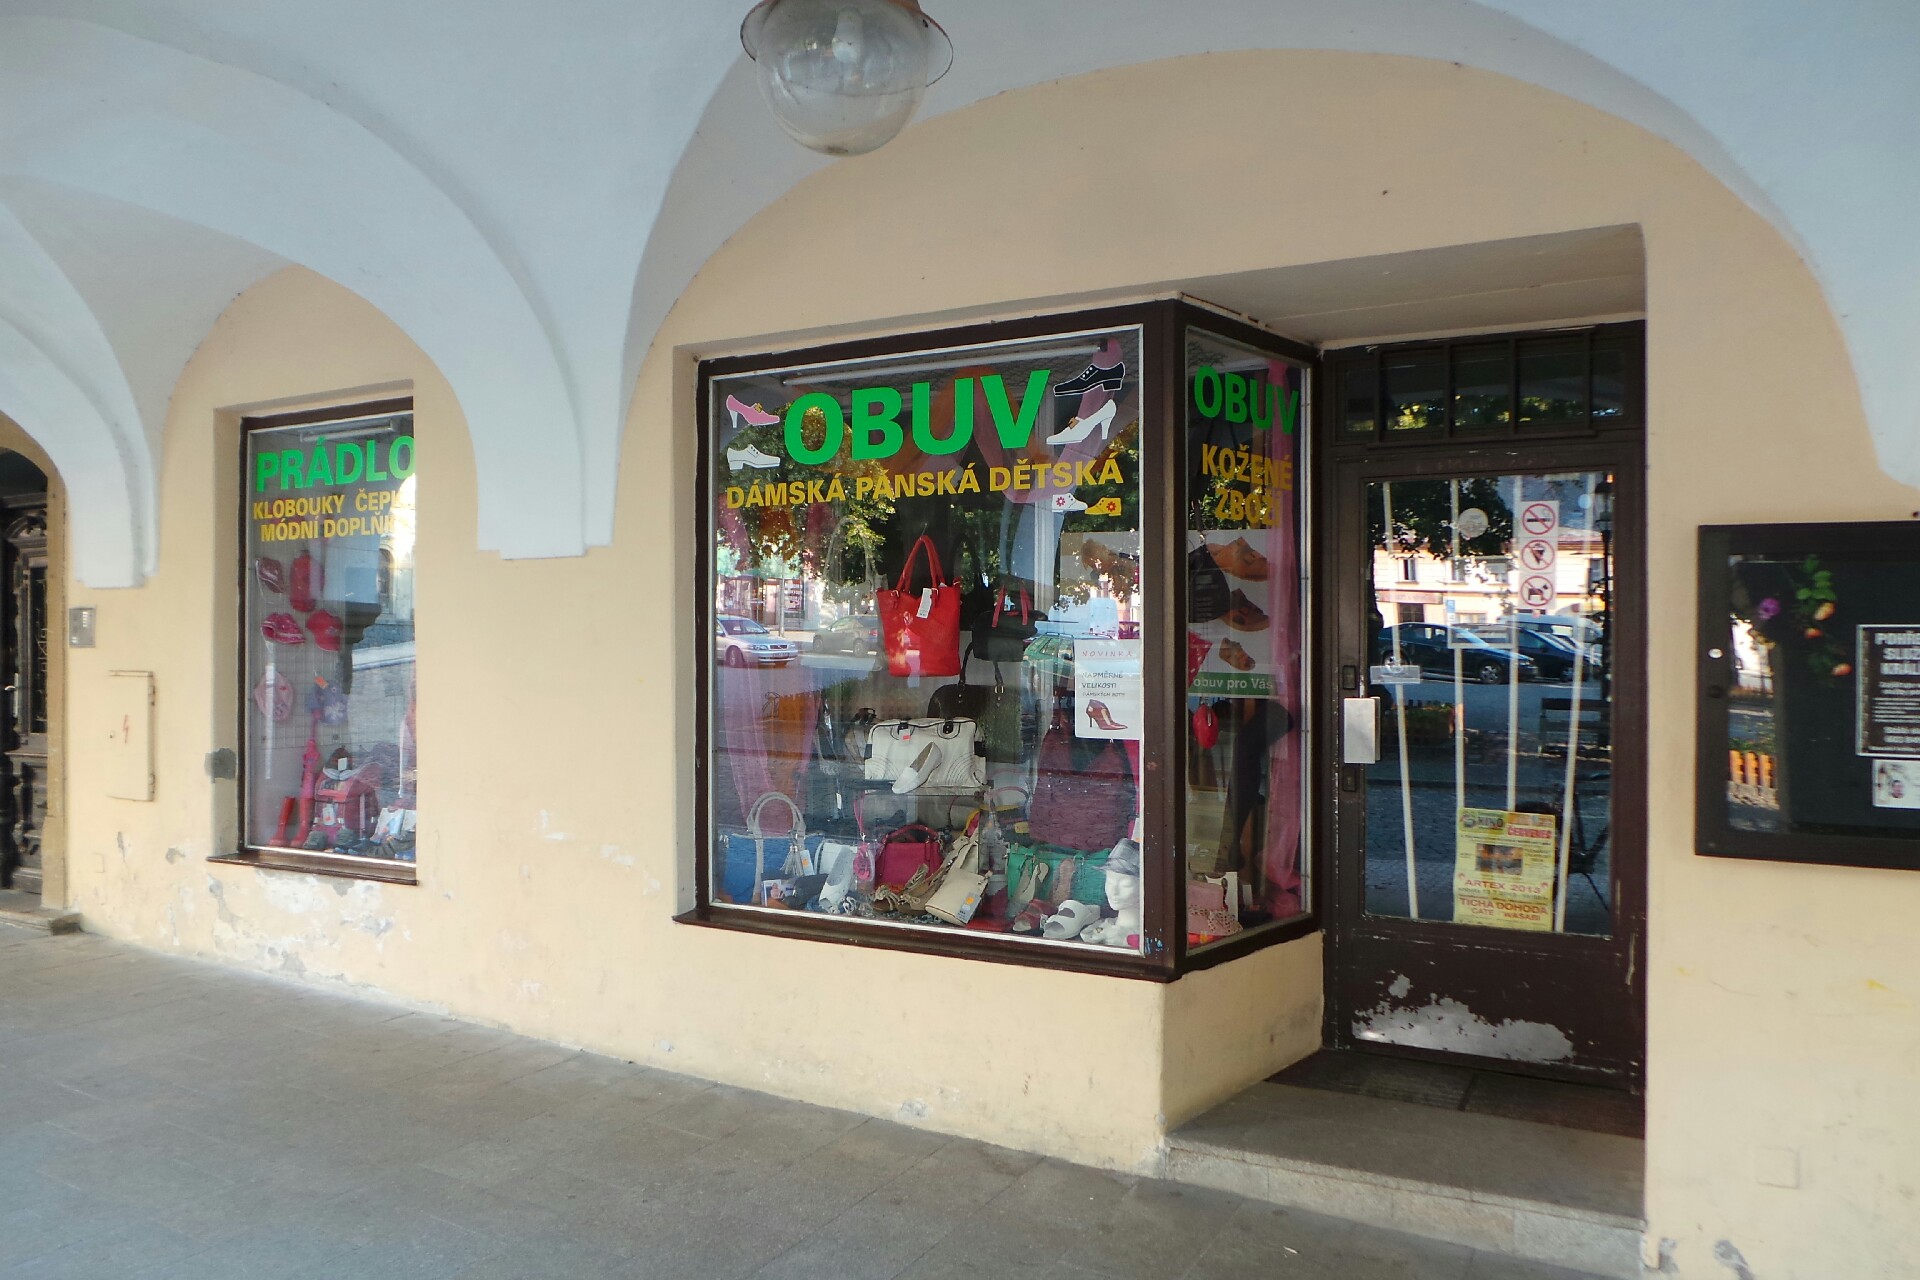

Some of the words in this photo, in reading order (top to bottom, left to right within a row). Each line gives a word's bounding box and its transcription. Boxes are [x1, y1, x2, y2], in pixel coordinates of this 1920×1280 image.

[1193, 364, 1300, 435] OBUV
[783, 369, 1051, 465] OBUV
[256, 435, 416, 491] PRÁDLO
[1201, 442, 1294, 491] KOŽENÉ
[726, 473, 846, 509] DÁMSKÁ
[856, 462, 981, 501] PÁNSKÁ
[990, 453, 1124, 493] DĚTSKÁ
[253, 493, 345, 520] KLOBOUKY
[1215, 486, 1282, 528] ZBOŽÍ
[260, 517, 319, 543] MÓDNÍ
[1082, 649, 1133, 657] NOVINKA
[1227, 679, 1247, 691] pro
[1250, 677, 1274, 689] Vás
[1464, 879, 1506, 890] ARTEX
[1496, 901, 1548, 915] DOHODA
